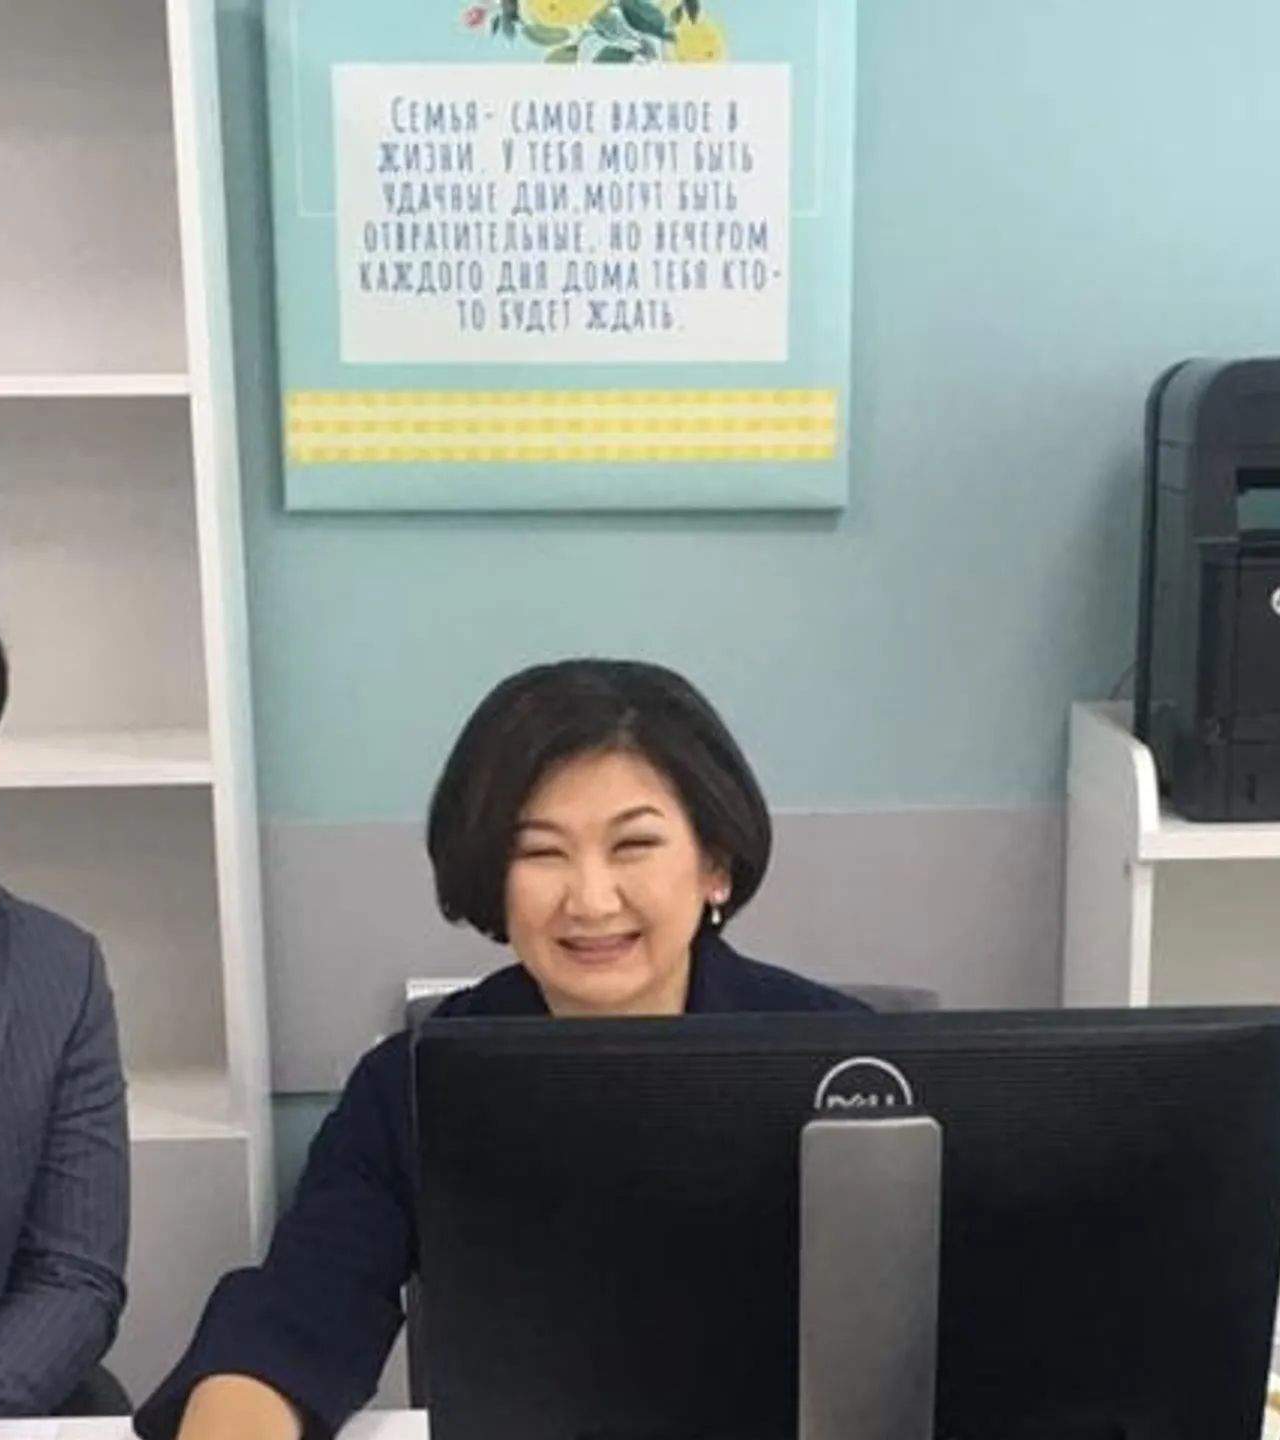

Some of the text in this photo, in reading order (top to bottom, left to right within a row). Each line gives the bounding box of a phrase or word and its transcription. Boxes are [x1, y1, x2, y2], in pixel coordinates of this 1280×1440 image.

[510, 100, 595, 134] САМОЕ
[611, 100, 711, 134] ВАЖНОЕ
[727, 100, 738, 134] В
[501, 138, 514, 174] У
[527, 140, 584, 174] ТЕБЯ
[597, 140, 678, 174] МОГУТ
[693, 140, 754, 173] БЫТЬ
[382, 181, 496, 216] УДАЧНЫЕ
[678, 180, 739, 212] БЫТЬ
[608, 219, 642, 253] НО
[655, 219, 769, 253] ВЕЧЕРОМ
[359, 259, 484, 295] КАЖДОГО
[495, 259, 549, 294] ДНЯ
[561, 259, 640, 293] ДОМА
[652, 258, 708, 292] ТЕБЯ
[457, 299, 487, 332] ТО
[499, 299, 571, 332] БУДЕТ
